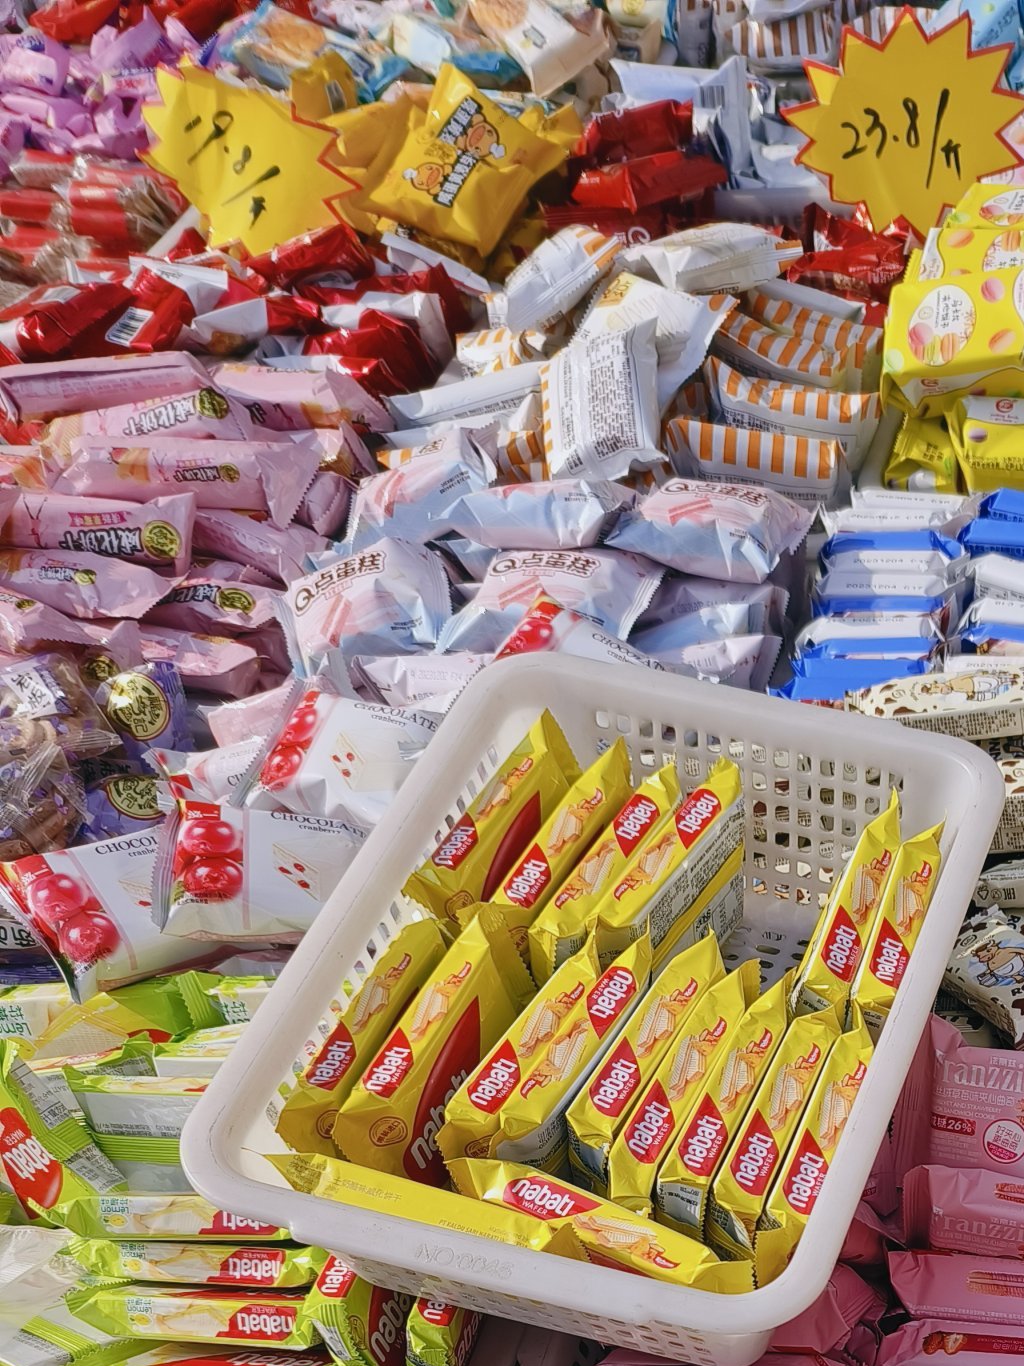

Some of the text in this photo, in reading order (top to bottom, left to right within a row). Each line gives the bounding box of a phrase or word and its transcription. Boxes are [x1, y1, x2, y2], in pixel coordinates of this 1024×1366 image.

[488, 552, 600, 578] Q点蛋糕
[615, 799, 658, 842] nabati
[678, 791, 719, 834] nabati
[826, 924, 858, 975] nabati
[875, 936, 905, 983] nabati
[590, 970, 633, 1019] nabati
[308, 1040, 353, 1085] nabati
[364, 1046, 411, 1093] nabati
[470, 1057, 518, 1107] nabati
[592, 1057, 638, 1110] nabati
[627, 1100, 672, 1156] nabati
[652, 1123, 671, 1146] WAFER
[682, 1114, 724, 1169] nabati
[707, 1134, 724, 1159] WAFER
[735, 1132, 774, 1187] nabati
[758, 1153, 776, 1178] WAFER
[787, 1150, 826, 1208] nabati
[511, 1178, 576, 1218] nabati
[522, 1200, 548, 1217] WAFER
[228, 1257, 281, 1278] nabati
[236, 1313, 295, 1335] nabati
